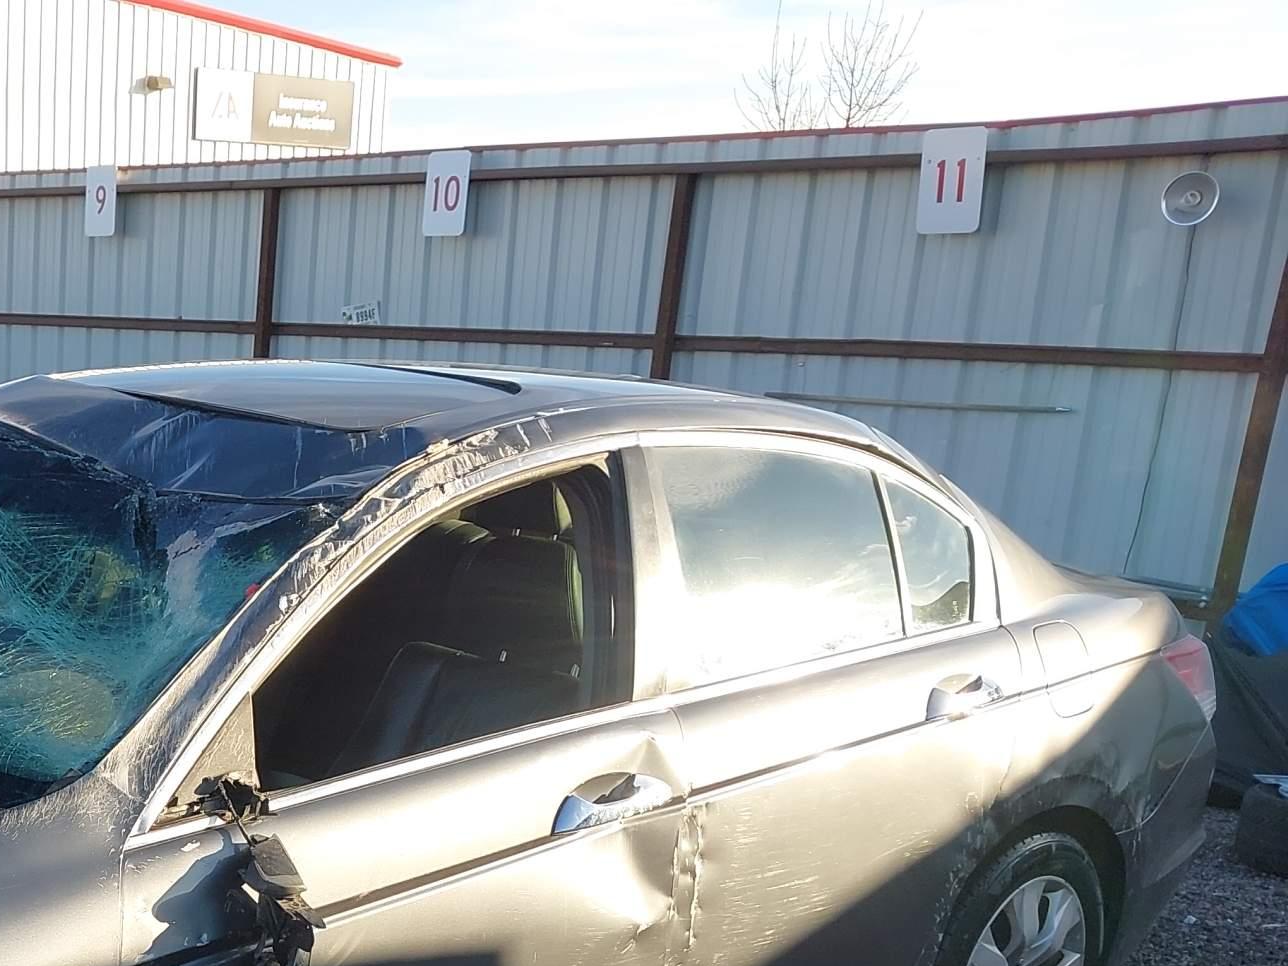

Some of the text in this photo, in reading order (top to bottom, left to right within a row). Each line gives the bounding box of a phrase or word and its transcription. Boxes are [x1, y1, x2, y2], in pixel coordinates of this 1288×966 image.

[432, 175, 461, 212] 10
[935, 158, 967, 204] 11
[95, 185, 107, 215] 9
